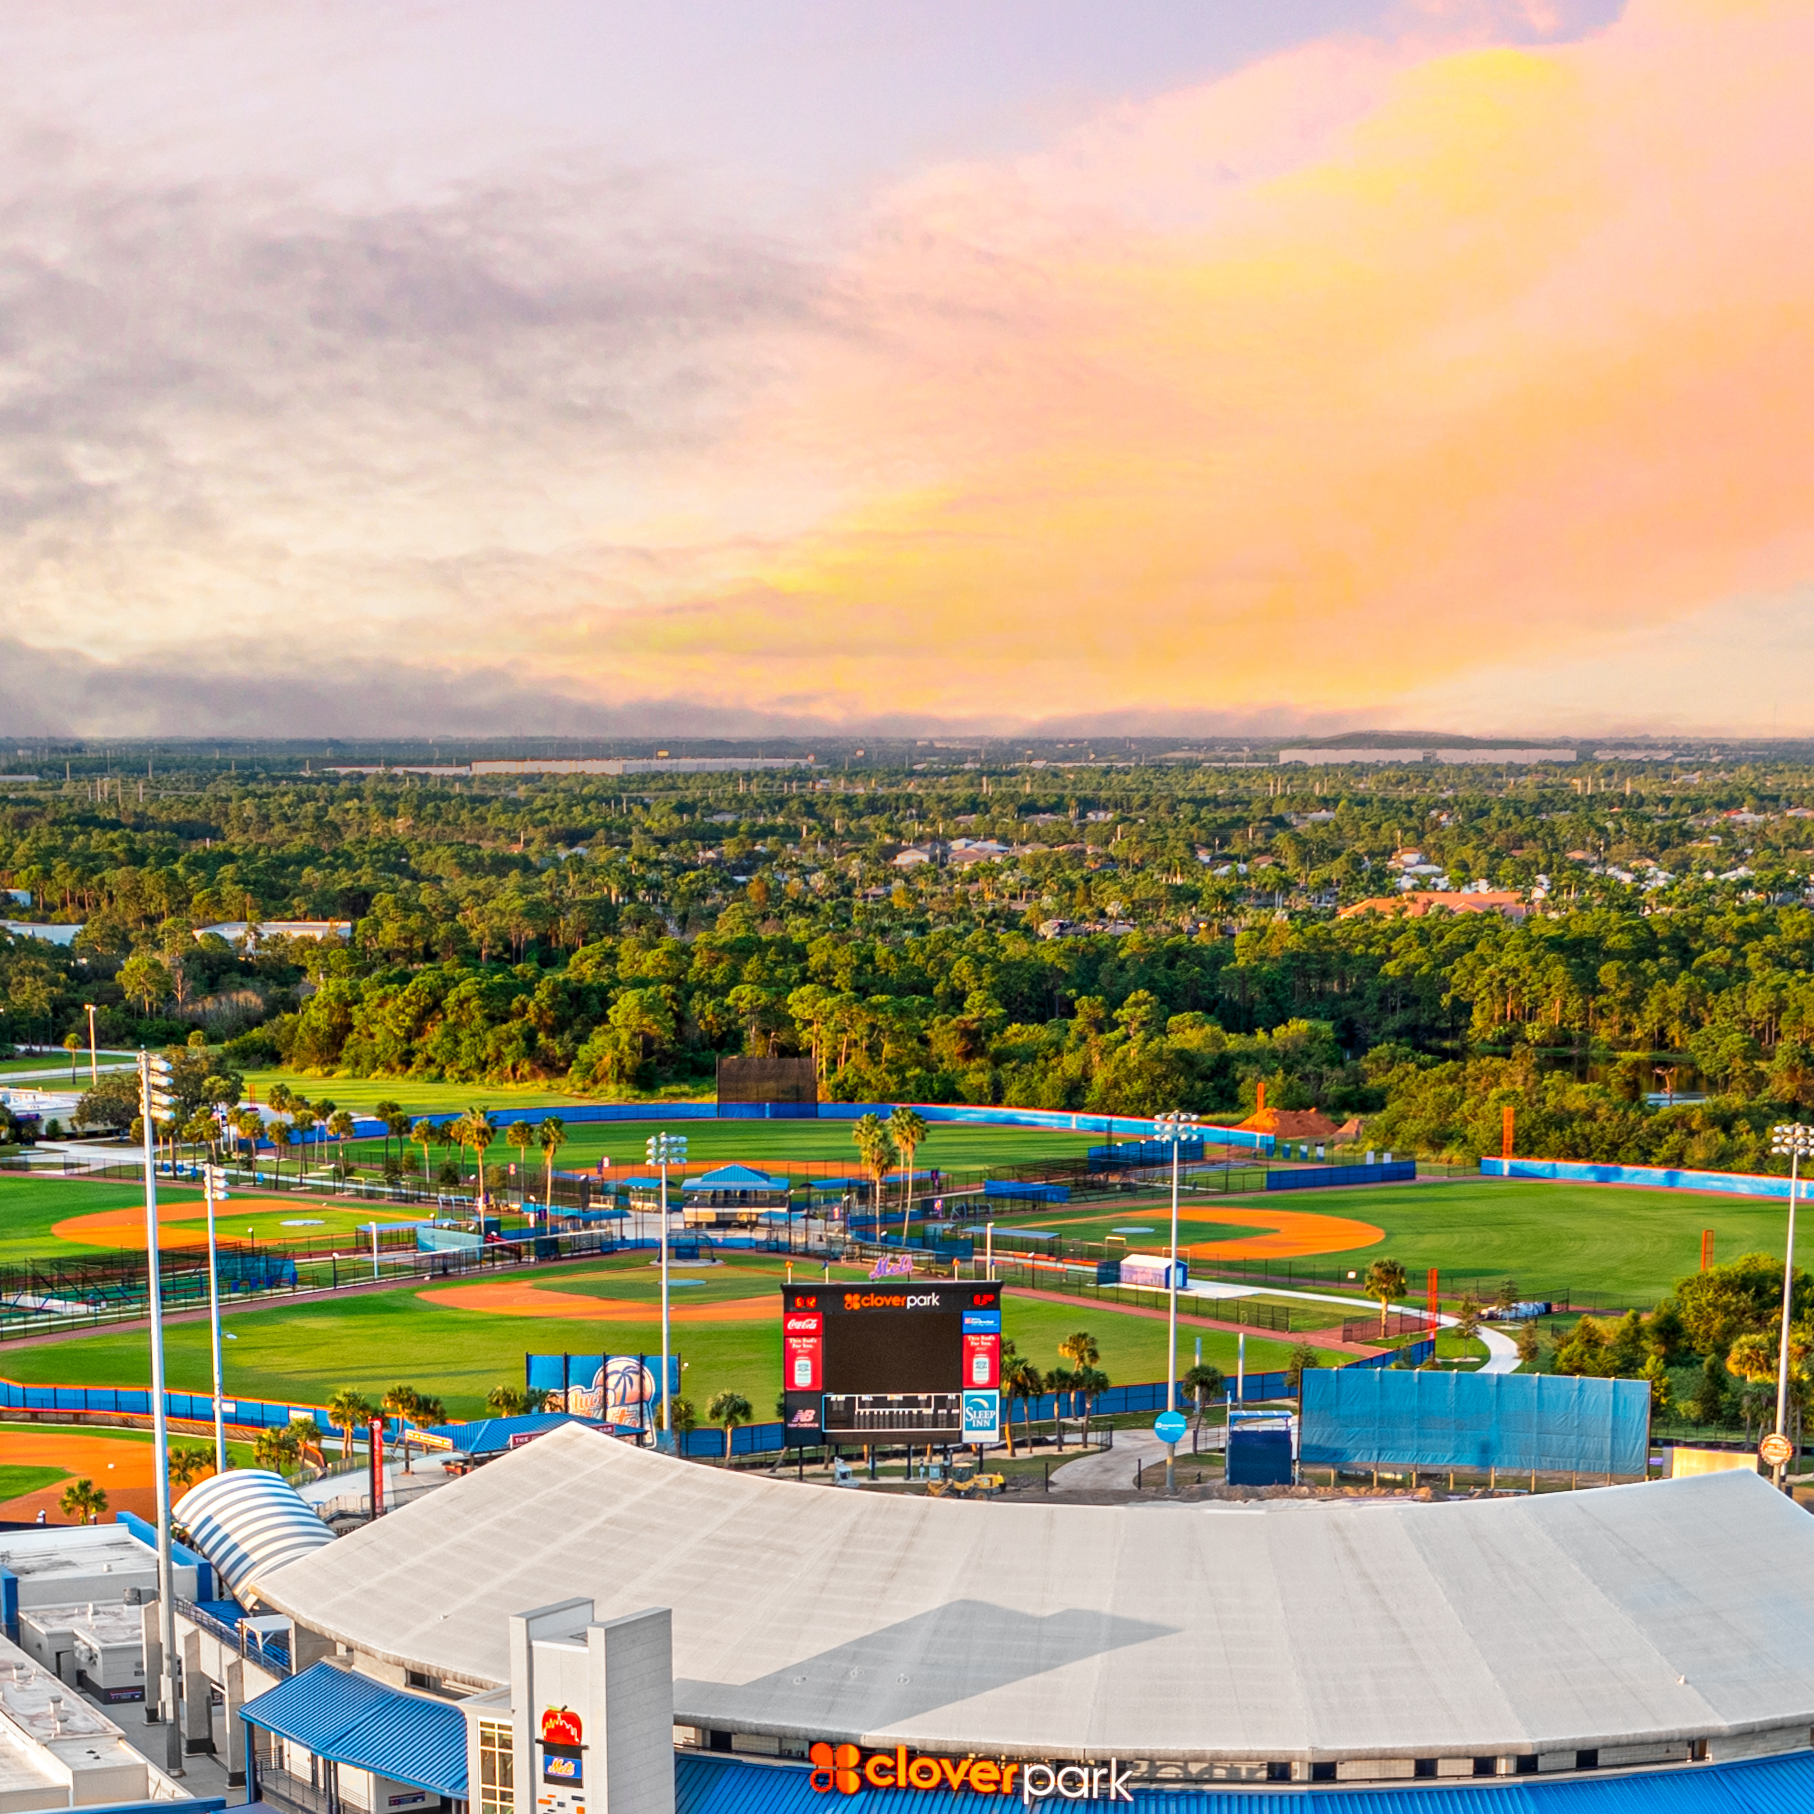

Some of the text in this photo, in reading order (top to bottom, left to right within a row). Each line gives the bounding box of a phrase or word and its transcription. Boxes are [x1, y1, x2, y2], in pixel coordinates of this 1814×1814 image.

[869, 1254, 914, 1279] Mets
[965, 1406, 996, 1421] SLEEP
[971, 1418, 991, 1428] INN
